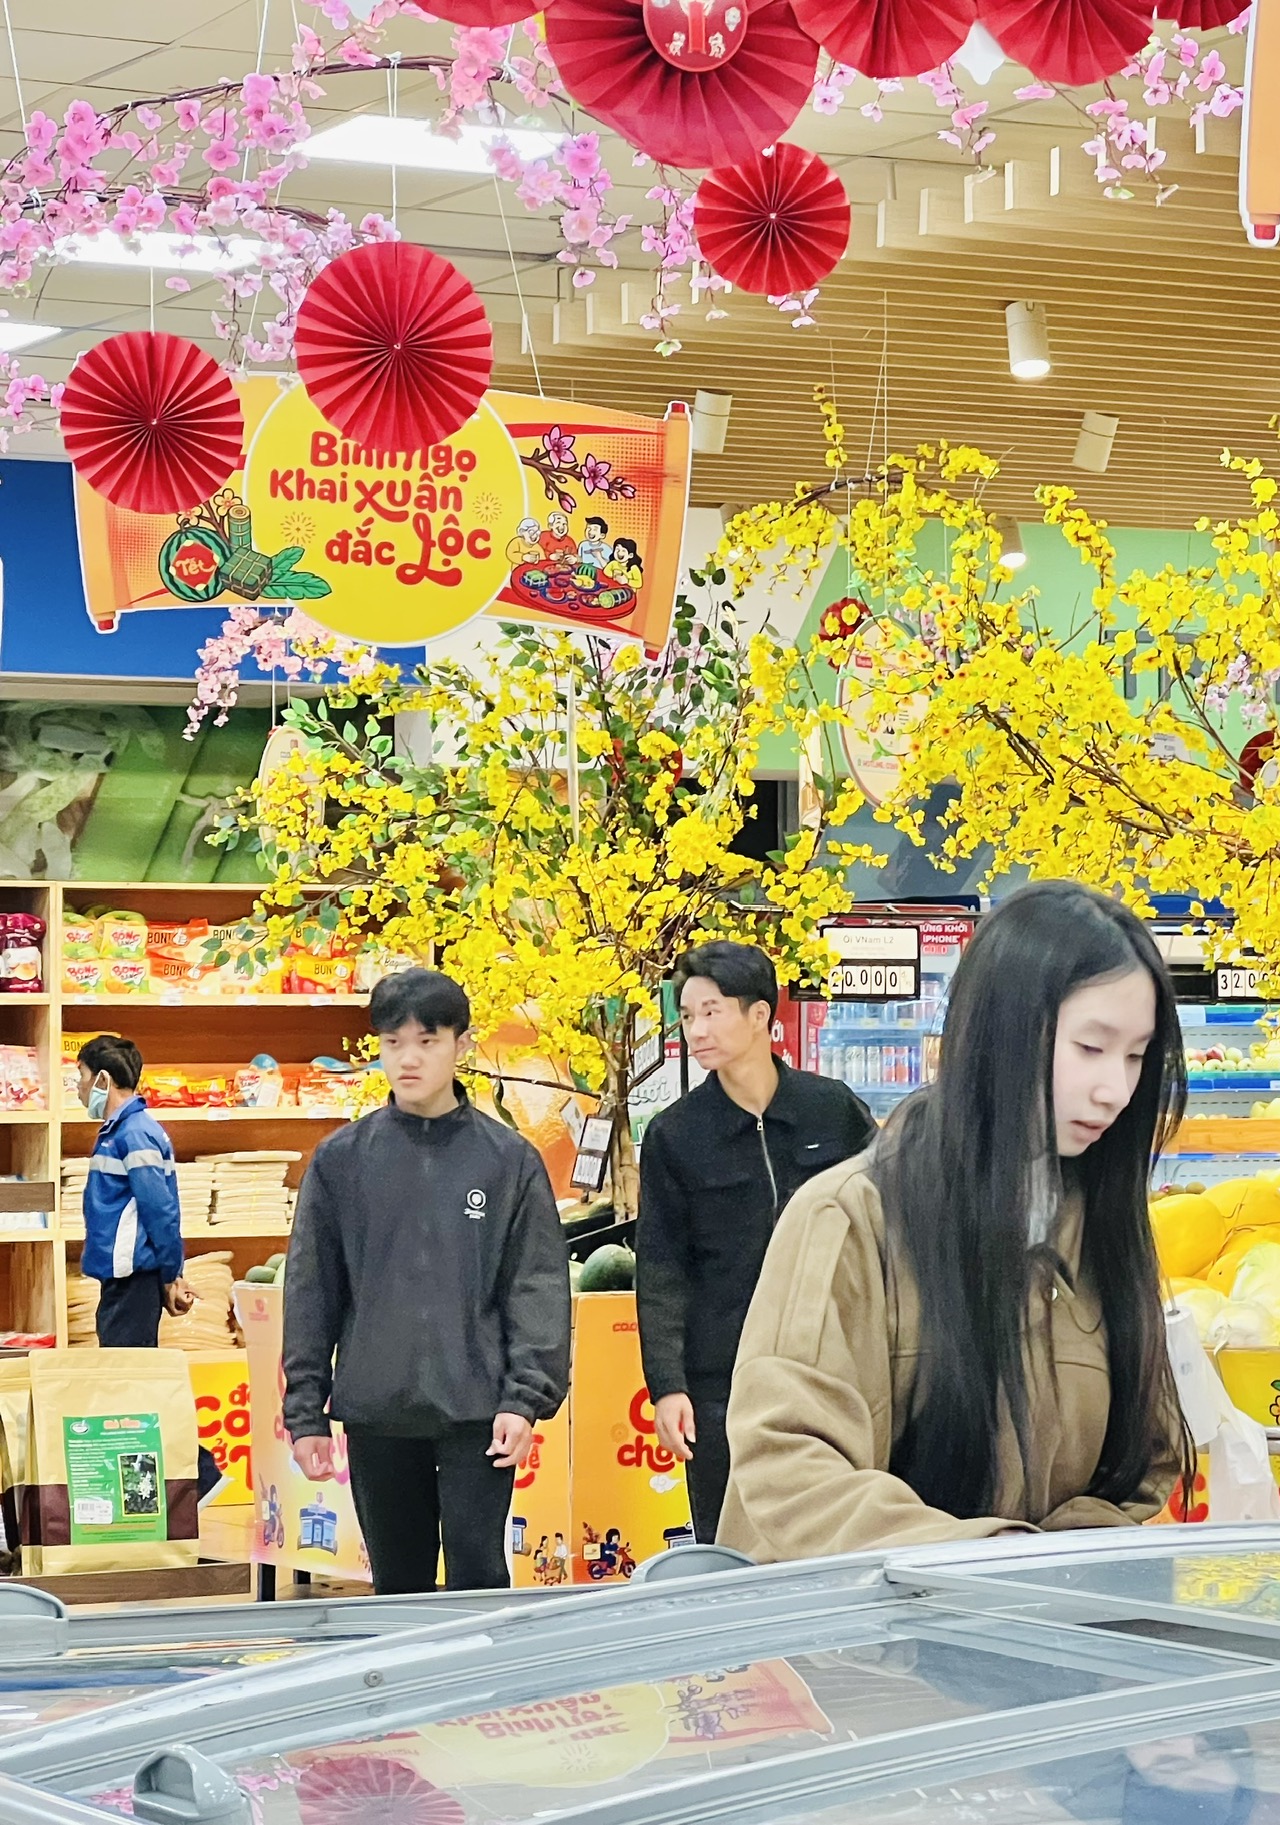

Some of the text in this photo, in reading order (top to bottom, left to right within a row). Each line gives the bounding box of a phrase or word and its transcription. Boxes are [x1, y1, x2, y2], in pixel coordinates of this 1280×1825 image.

[269, 468, 348, 503] Khai
[176, 557, 216, 576] Tết
[325, 512, 491, 587] đắc Lộc
